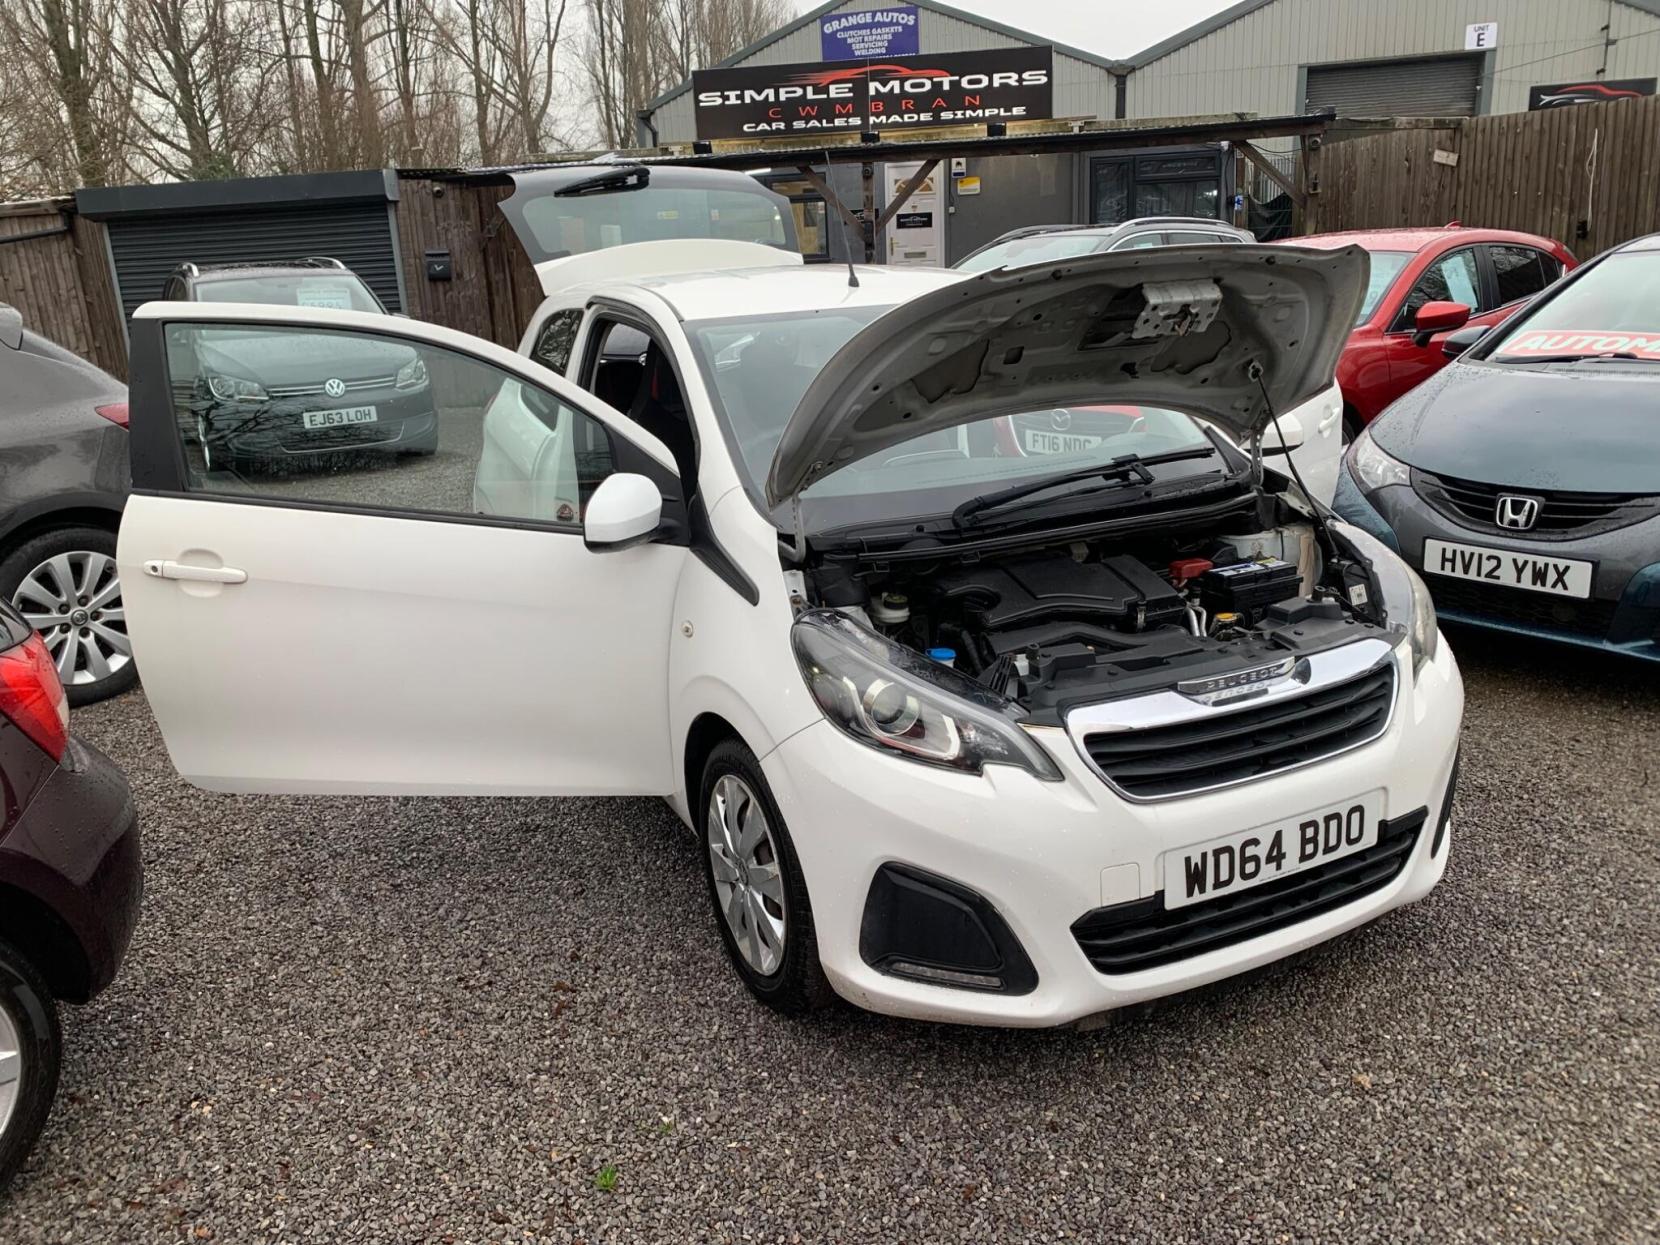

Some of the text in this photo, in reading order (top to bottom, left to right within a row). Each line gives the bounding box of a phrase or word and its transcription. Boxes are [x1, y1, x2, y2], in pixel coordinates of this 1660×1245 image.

[823, 12, 916, 33] GRANGE AUTOS
[837, 26, 902, 38] CLUTCHES GASKETS
[1474, 24, 1490, 33] UNIT
[852, 41, 888, 49] SERVICING
[1476, 32, 1486, 47] E
[854, 48, 886, 56] WELDING
[698, 70, 1048, 106] SIMPLE MOTORS
[768, 95, 980, 118] CWMBRAN
[743, 106, 1027, 132] CAR SALES MADE SIMPLE
[309, 409, 372, 427] EJ63 LOH
[1032, 433, 1060, 452] FT16
[1440, 547, 1571, 591] HV12 YWX
[1184, 804, 1365, 899] WD64 BDO
